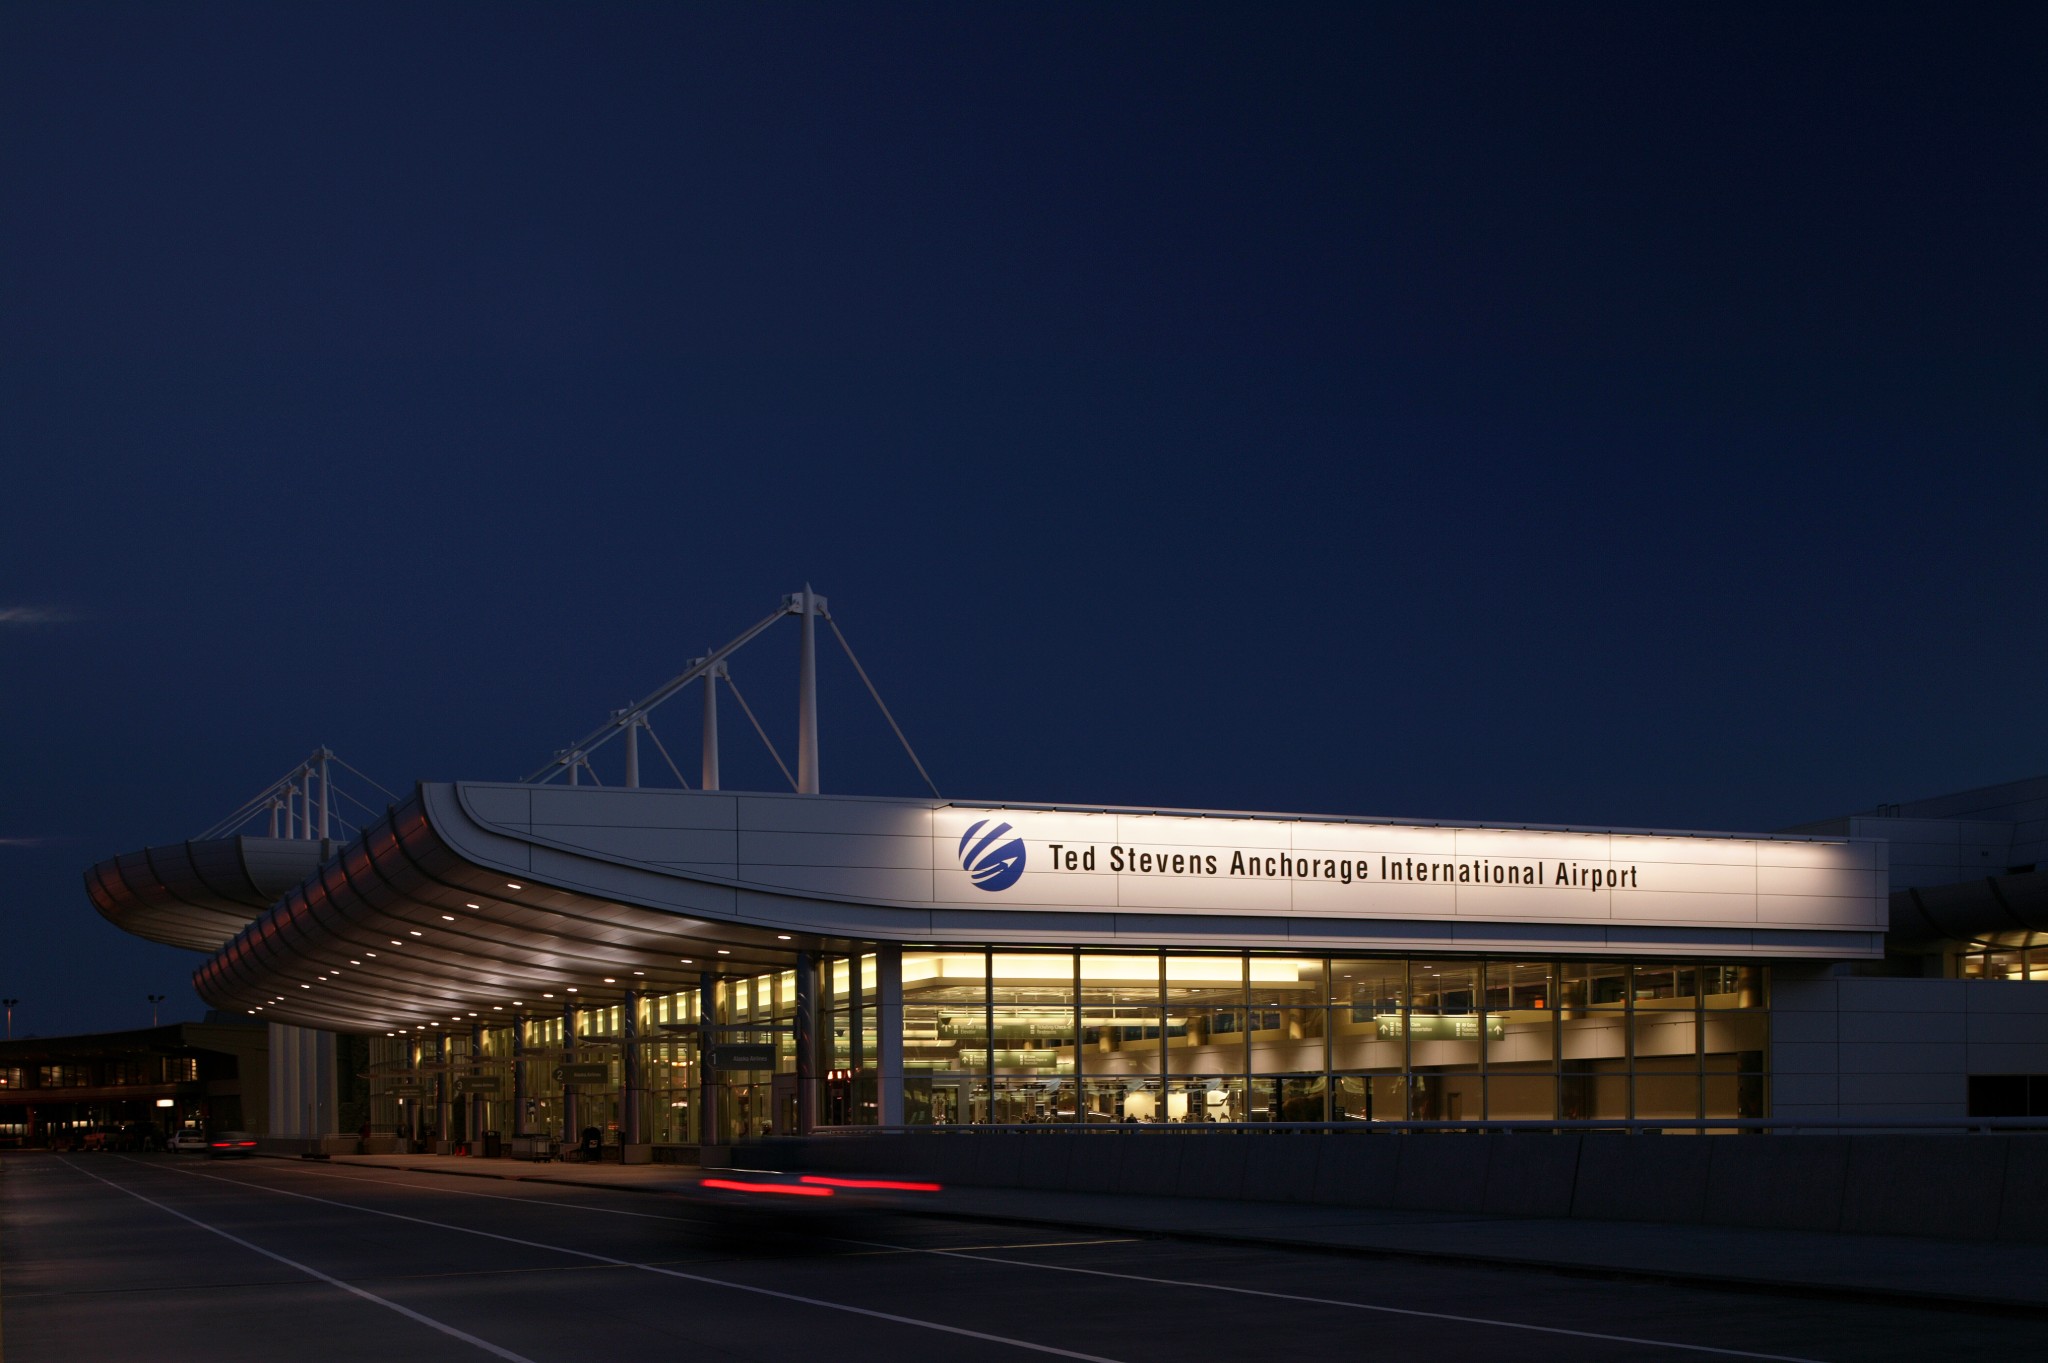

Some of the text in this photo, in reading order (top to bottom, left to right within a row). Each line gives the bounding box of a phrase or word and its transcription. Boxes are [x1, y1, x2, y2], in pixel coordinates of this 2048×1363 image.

[1049, 845, 1637, 892] Ted Stevens Anchorage International Airport
[711, 1053, 717, 1065] 1
[557, 1070, 563, 1080] 2
[457, 1081, 463, 1090] 3
